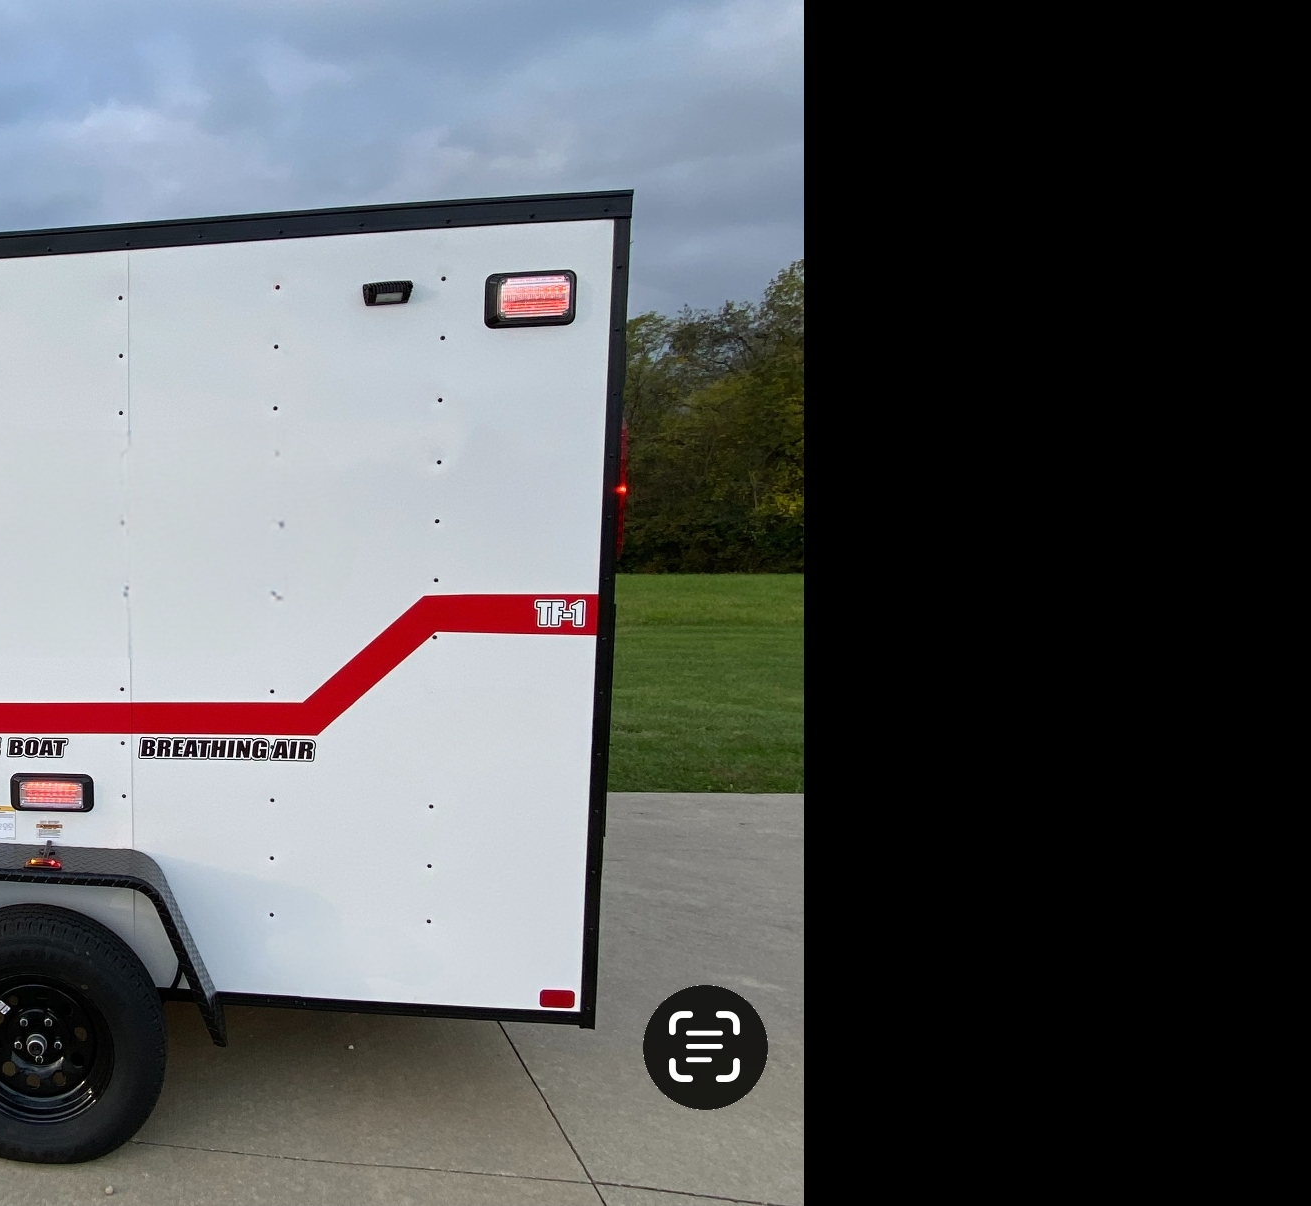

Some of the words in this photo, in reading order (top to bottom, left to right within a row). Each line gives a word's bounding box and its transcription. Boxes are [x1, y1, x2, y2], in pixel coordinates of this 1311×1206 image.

[534, 599, 586, 627] TF-1
[7, 737, 69, 758] BOAT
[138, 737, 269, 760] BREATHING
[270, 739, 316, 762] AIR
